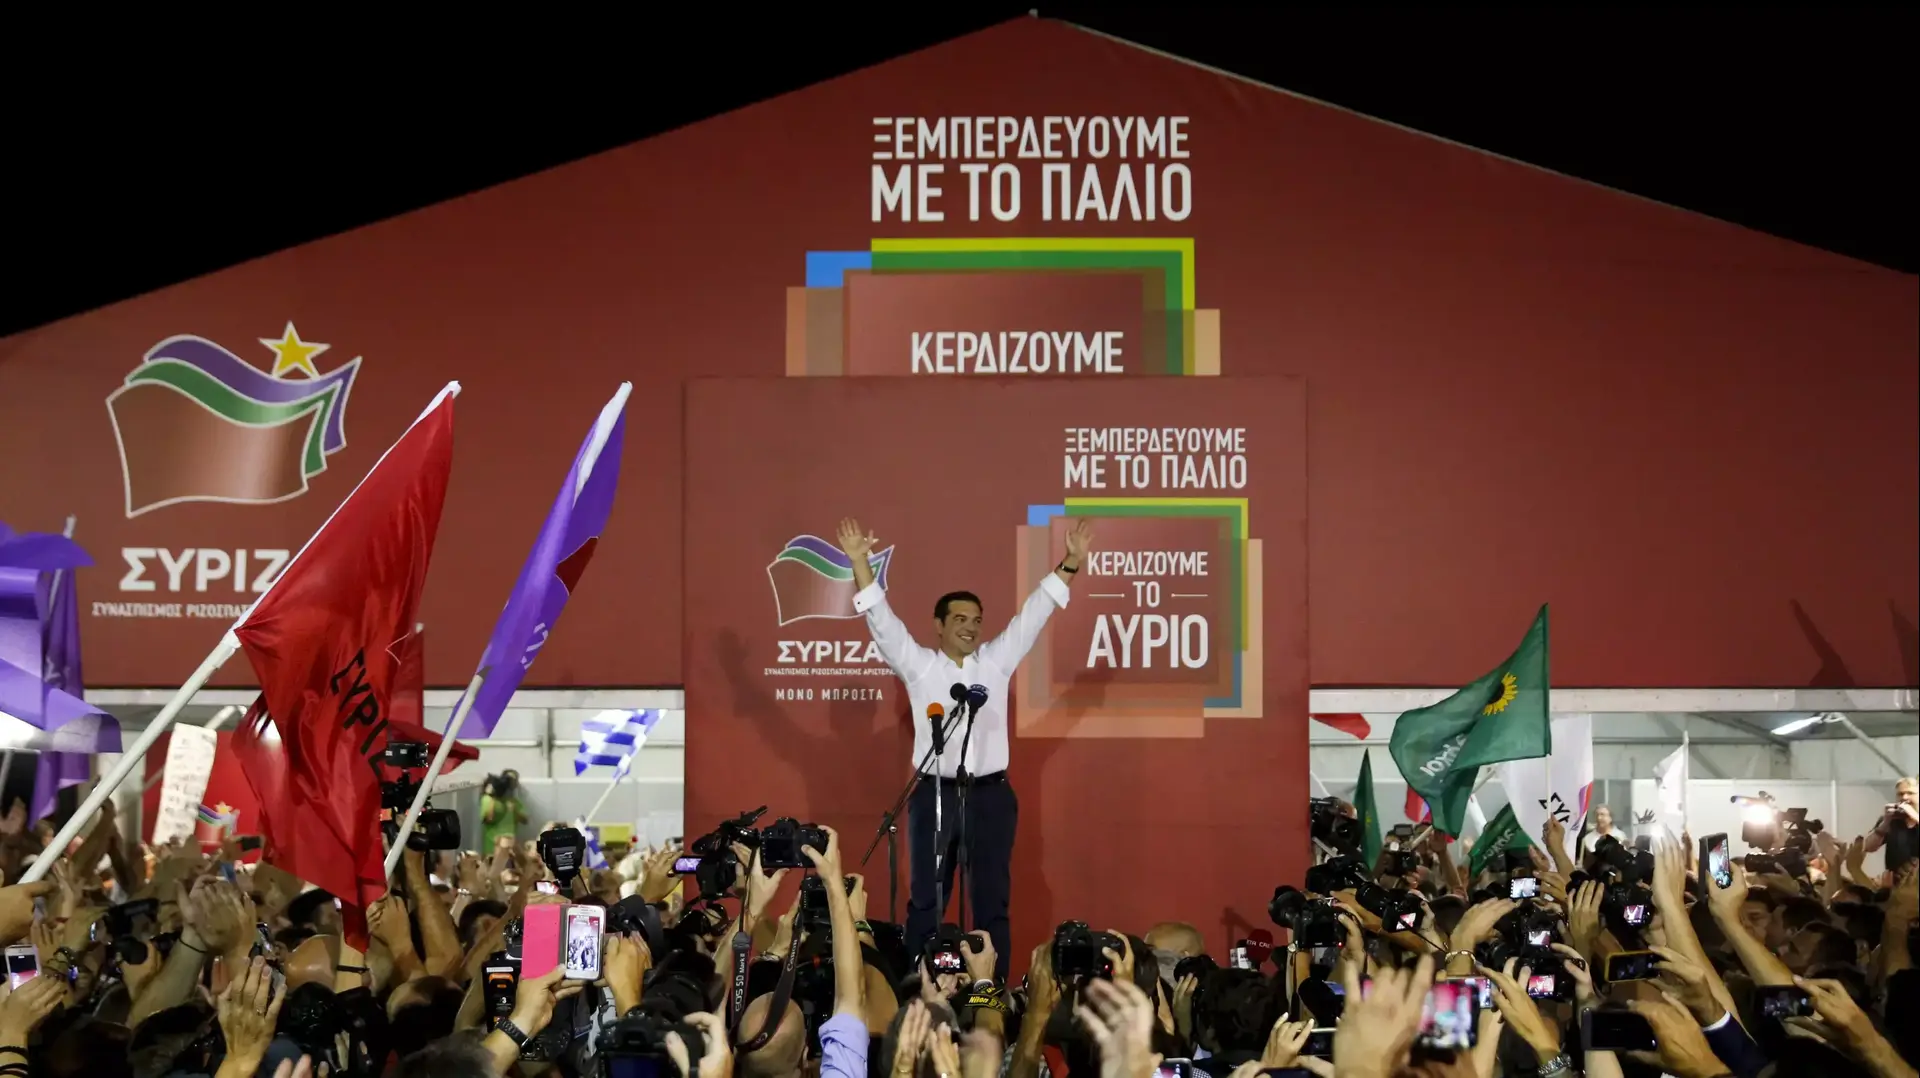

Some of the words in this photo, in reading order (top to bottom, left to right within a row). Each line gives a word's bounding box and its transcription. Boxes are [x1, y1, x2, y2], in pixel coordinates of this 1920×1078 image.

[872, 116, 1190, 159] ΞΕΜΠΕΡΔΕΥΟΥΜΕ
[871, 164, 945, 222] ΜΕ
[959, 163, 1020, 221] ΤΟ
[1042, 163, 1192, 221] ΠΑΛΙΟ
[911, 331, 1124, 374] ΚΕΡΔΙΖΟΥΜΕ
[1065, 427, 1246, 452] ΞΕΜΠΕΡΔΕΥΟΥΜΕ
[1064, 455, 1107, 489] ΜΕ
[1115, 454, 1150, 489] ΤΟ
[1161, 454, 1247, 489] ΠΑΛΙΟ
[119, 547, 290, 593] ΣΥΡΙΖ
[1087, 551, 1209, 576] ΚΕΡΔΙΖΟΥΜΕ
[1132, 581, 1161, 608] ΤΟ
[186, 603, 252, 619] ΡΙΖΟΣΠΑ
[777, 640, 885, 663] ΣΥΡΙΖΑ
[1086, 614, 1209, 669] ΑΥΡΙΟ
[775, 688, 814, 701] ΜΟΝΟ
[821, 688, 883, 701] ΜΠΡΟΣΤΑ
[786, 939, 798, 972] Canon
[735, 989, 744, 1012] EOS
